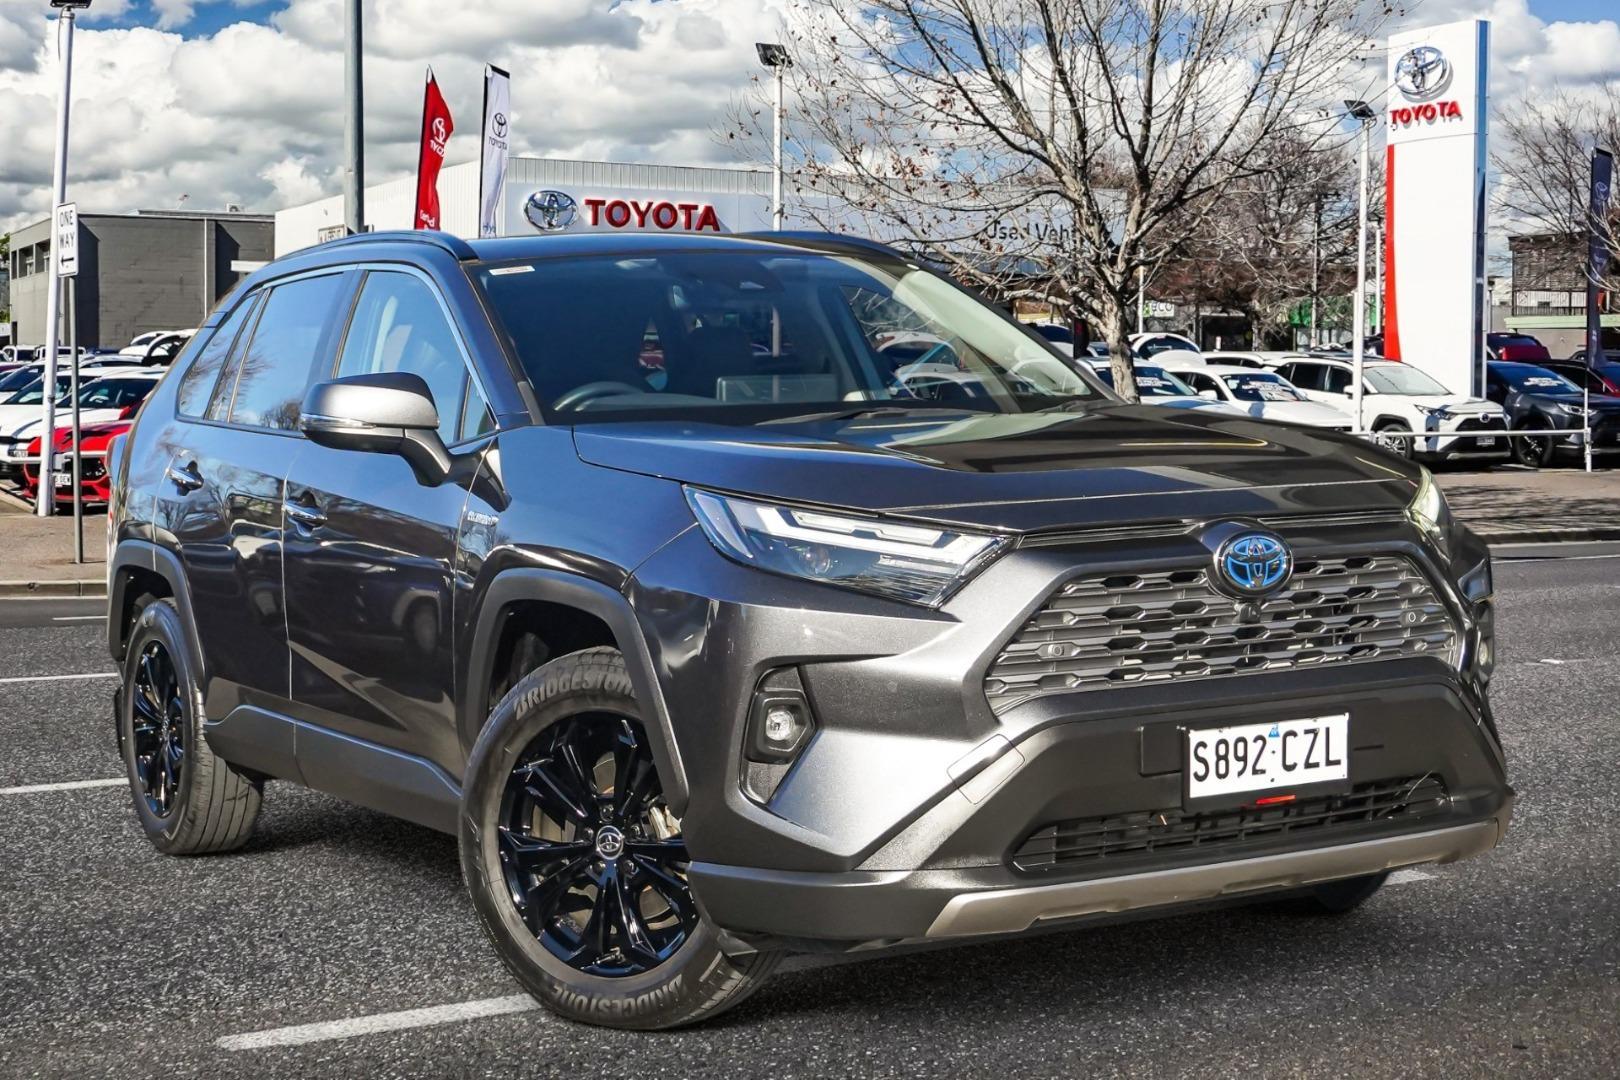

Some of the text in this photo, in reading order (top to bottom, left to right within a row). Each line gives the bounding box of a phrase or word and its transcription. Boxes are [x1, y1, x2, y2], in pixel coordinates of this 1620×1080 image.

[1389, 101, 1462, 124] TOYOTA
[59, 209, 74, 228] ONE
[584, 199, 720, 232] TOYOTA
[59, 231, 75, 249] WAY
